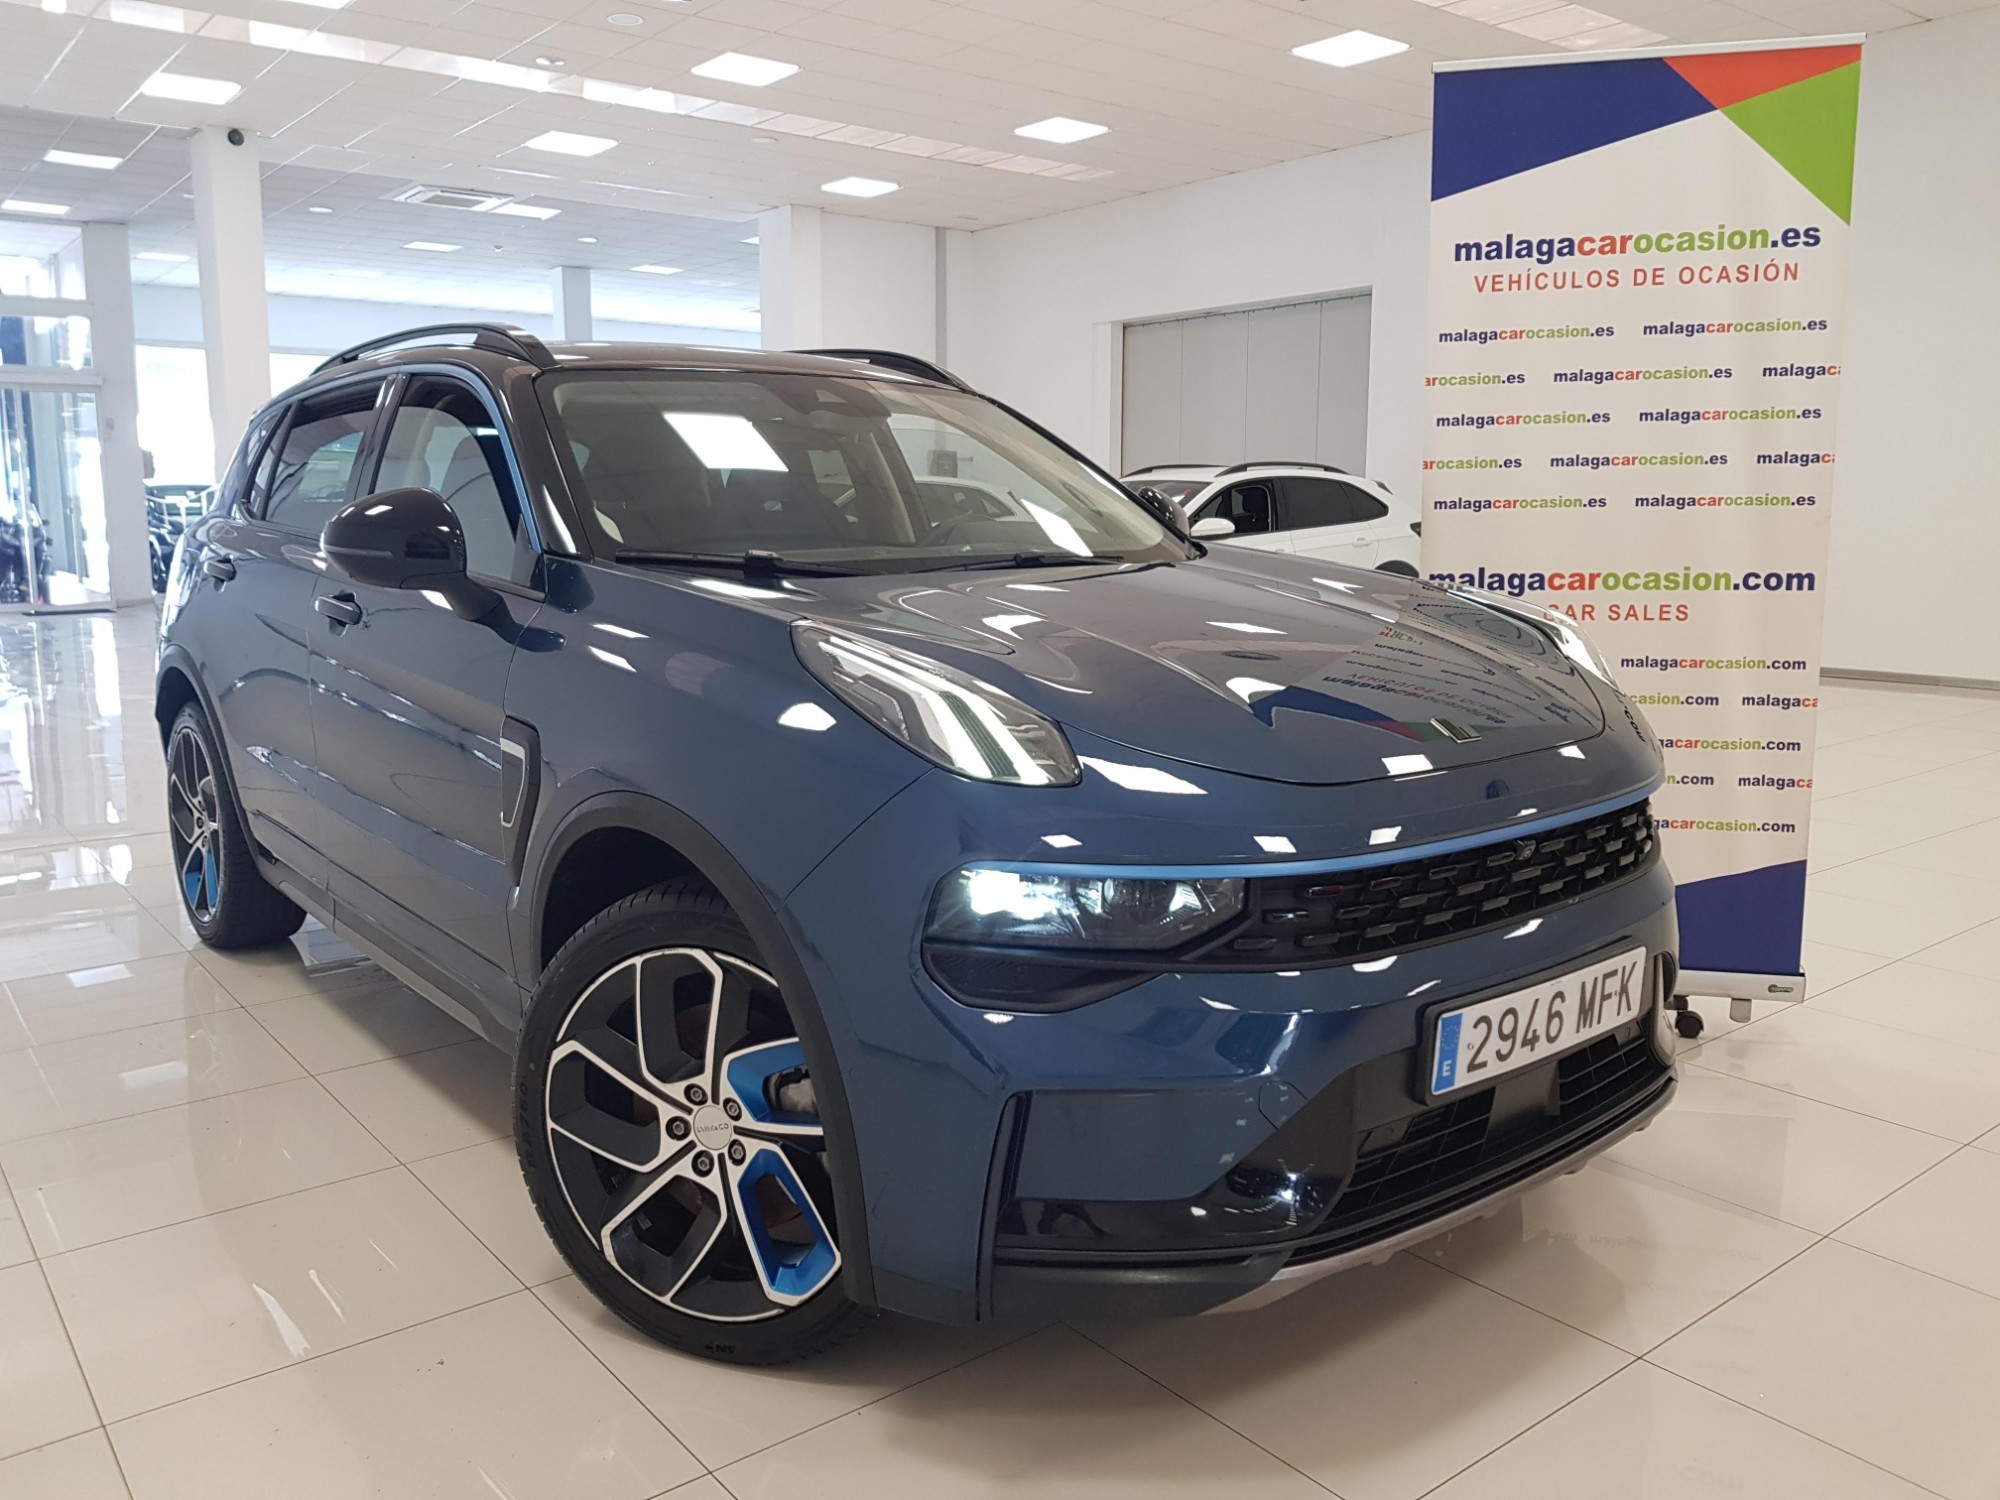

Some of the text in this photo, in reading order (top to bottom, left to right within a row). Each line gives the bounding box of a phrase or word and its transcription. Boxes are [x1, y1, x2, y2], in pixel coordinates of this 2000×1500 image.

[1454, 224, 1821, 265] malagacarocasion.es
[1474, 258, 1799, 293] VEHÍCULOS DE OCASIÓN
[1438, 318, 1828, 345] malagacarocasion.es malagacarocasion.es
[1553, 366, 1733, 385] malagacarocasion.es
[1436, 406, 1822, 430] malagacarocasion.es malagacarocasion.es
[1550, 452, 1728, 471] malagacarocasion.es
[1434, 493, 1816, 513] malagacarocasion.es malagacarocasion.es
[1608, 604, 1689, 622] SALES
[1621, 656, 1806, 672] malagacarocasion.com
[1467, 961, 1638, 1073] 2946 MFK
[1442, 1060, 1452, 1077] E
